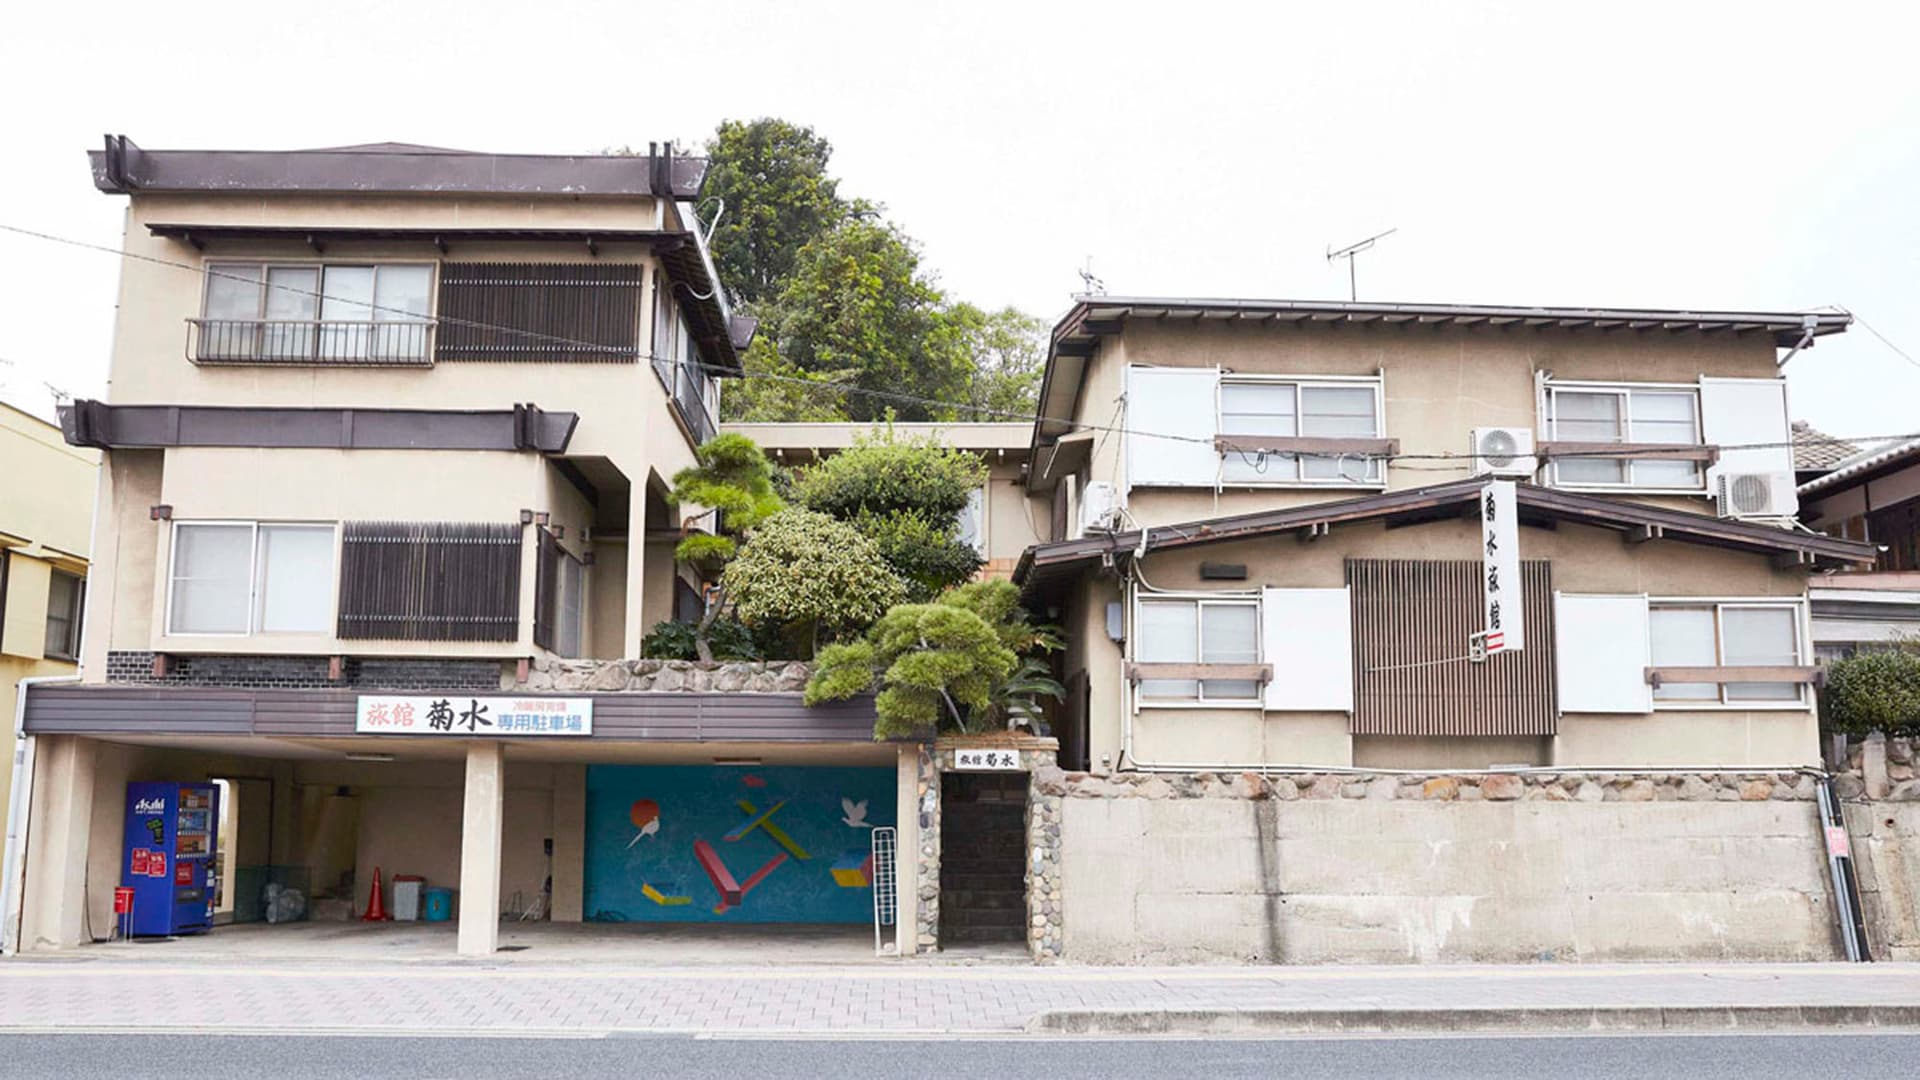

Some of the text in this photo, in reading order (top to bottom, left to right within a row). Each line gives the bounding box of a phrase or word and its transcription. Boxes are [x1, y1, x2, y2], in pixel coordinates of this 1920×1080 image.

[1485, 491, 1500, 630] 菊水旅館
[366, 699, 493, 732] 旅館 菊水
[986, 752, 1015, 767] 菊水
[135, 798, 165, 810] Asahi
